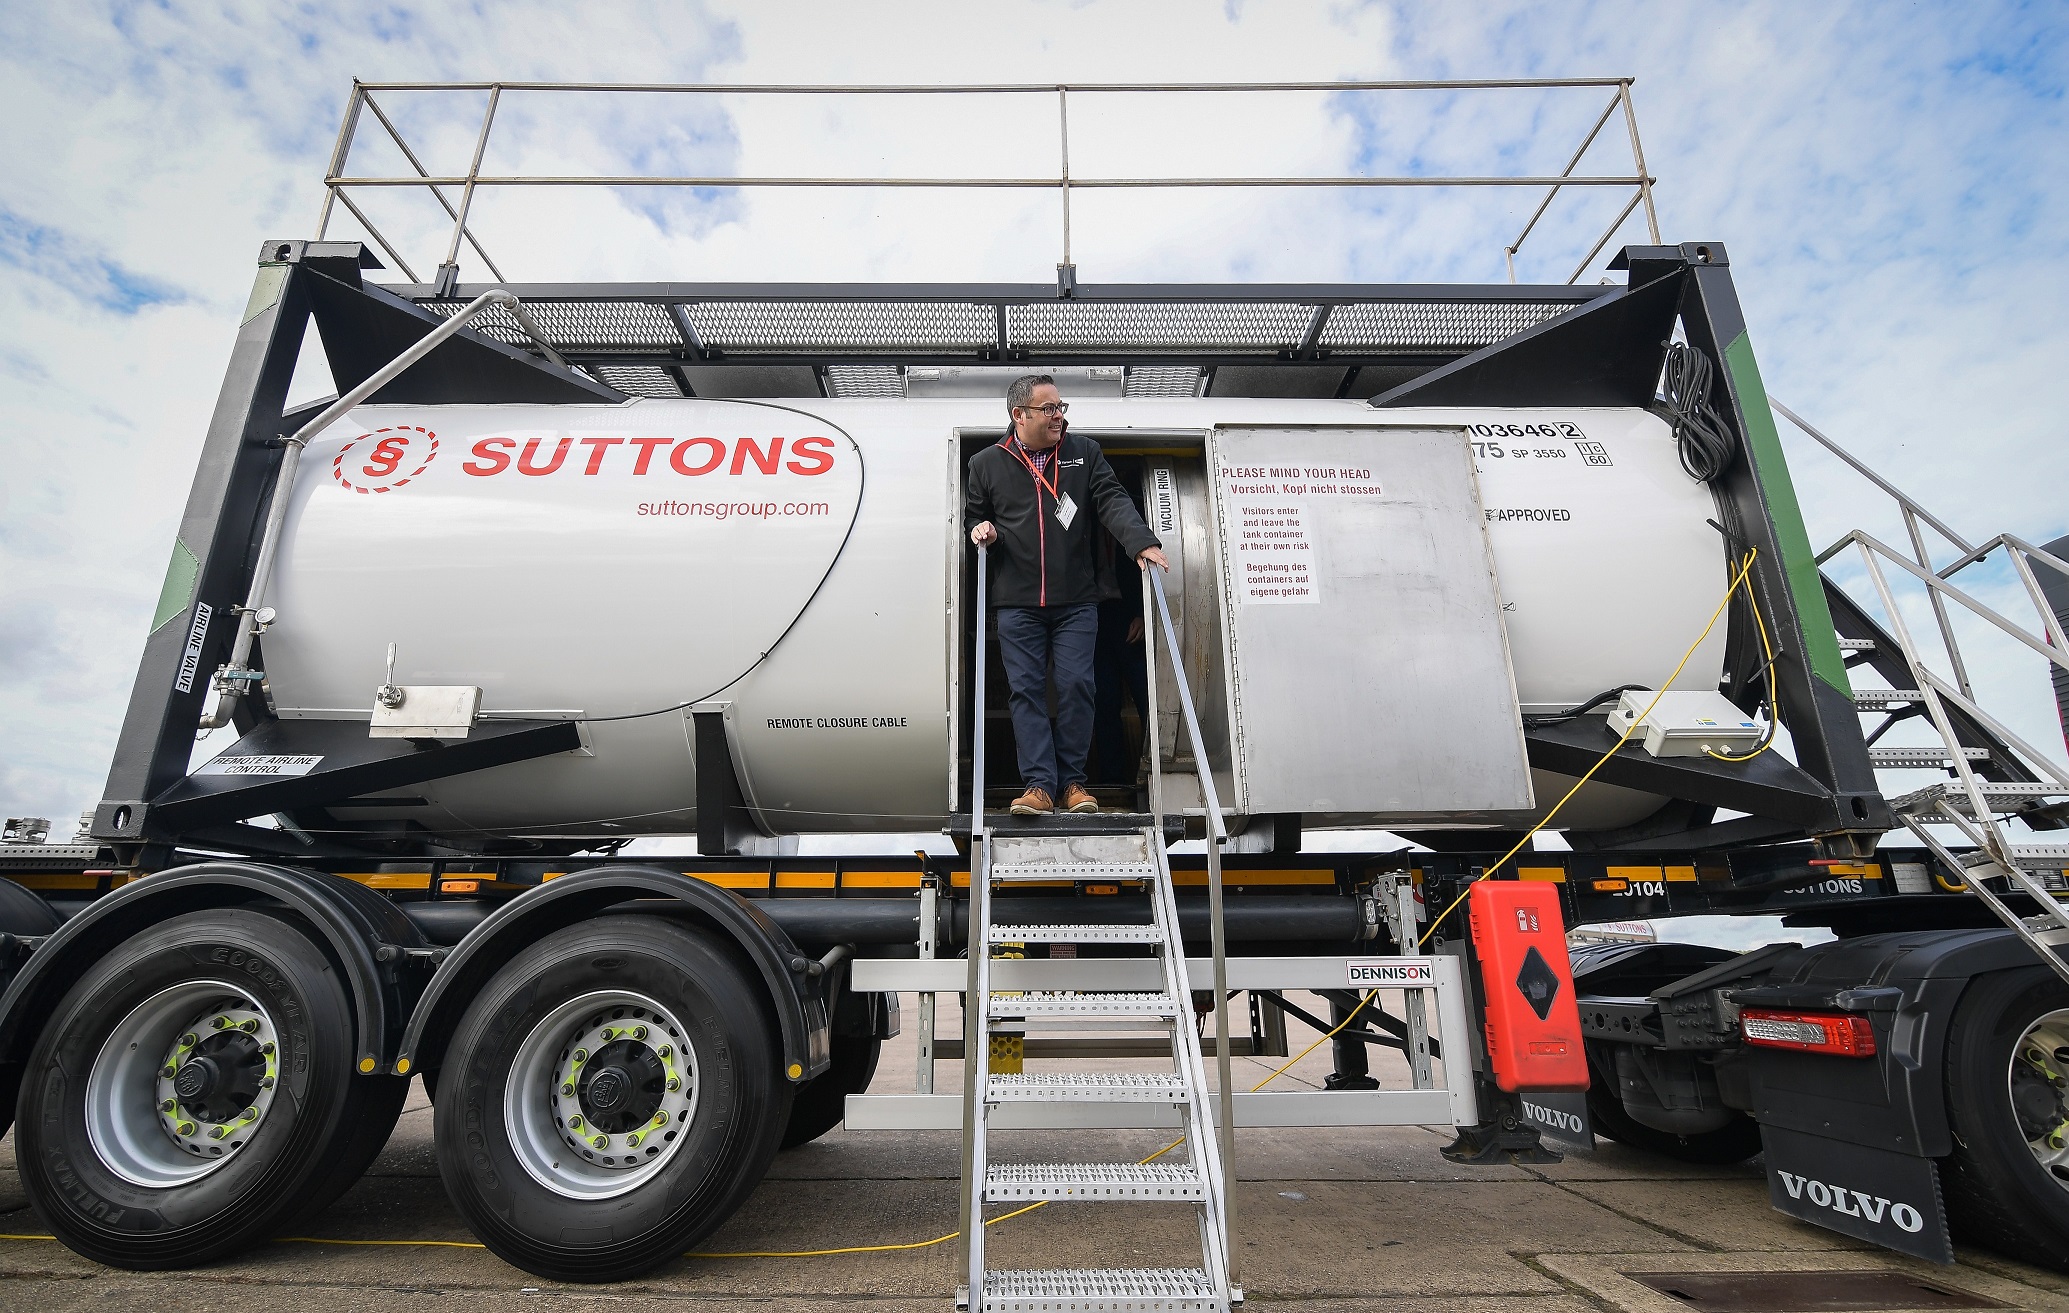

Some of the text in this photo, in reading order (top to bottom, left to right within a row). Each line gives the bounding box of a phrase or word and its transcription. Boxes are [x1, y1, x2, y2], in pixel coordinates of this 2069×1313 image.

[1560, 424, 1580, 437] 2
[462, 436, 835, 476] SUTTONS
[1511, 449, 1529, 458] SP
[1532, 449, 1566, 458] 3550
[1589, 455, 1606, 464] 60
[1222, 467, 1371, 479] PLEASE MIND YOUR HEAD
[1230, 484, 1381, 496] Vorsicht, Kopf nicht stossen
[1156, 470, 1173, 531] VACUUM RING
[637, 501, 829, 520] suttonsgroup.com
[1242, 507, 1299, 515] Visitors enter
[1498, 509, 1571, 521] APPROVED
[1243, 518, 1300, 527] and leave the
[1243, 530, 1304, 539] tank container
[1240, 542, 1249, 551] at
[1251, 542, 1271, 551] their
[1293, 542, 1310, 550] risk
[1246, 563, 1307, 573] Begehung des
[1247, 575, 1309, 584] containers auf
[1250, 587, 1310, 597] eigene gefahr
[179, 604, 209, 691] AIRLINE VALVE
[767, 717, 908, 729] REMOTE CLOSURE CABLE
[213, 756, 317, 765] REMOTE AIRLINE
[1350, 967, 1431, 980] DENNISON
[1522, 1100, 1583, 1134] VOLVO
[1777, 1170, 1924, 1233] VOLVO
